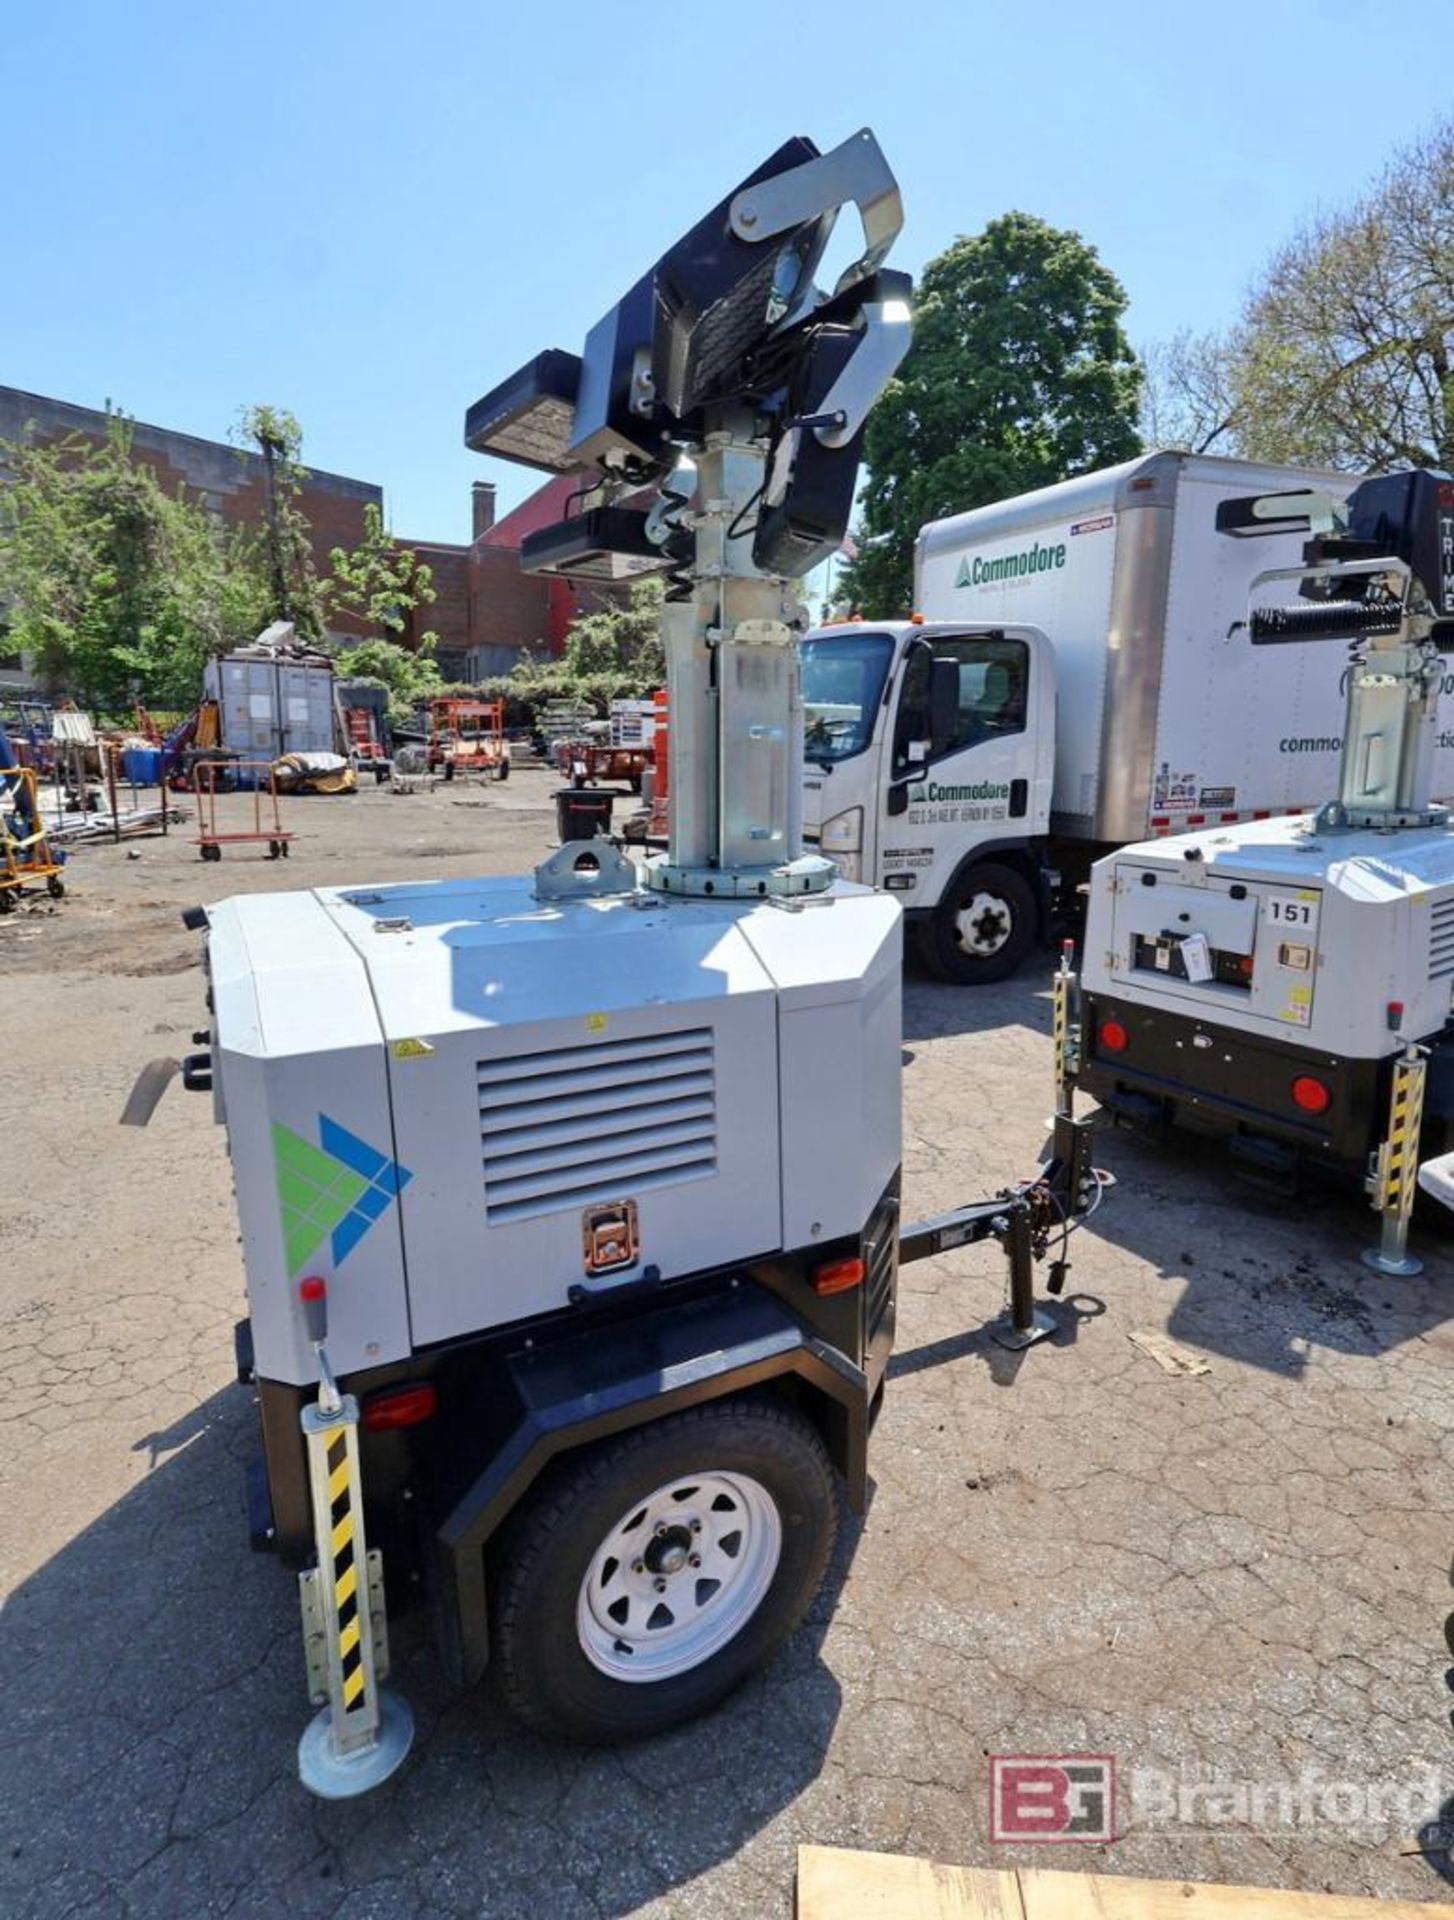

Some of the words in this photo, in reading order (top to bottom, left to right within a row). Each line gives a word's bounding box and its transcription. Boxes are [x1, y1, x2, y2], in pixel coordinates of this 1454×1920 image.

[972, 542, 1066, 585] Commodore
[1441, 517, 1454, 611] TRIME
[929, 780, 1009, 802] Commodore
[1272, 902, 1310, 924] 151
